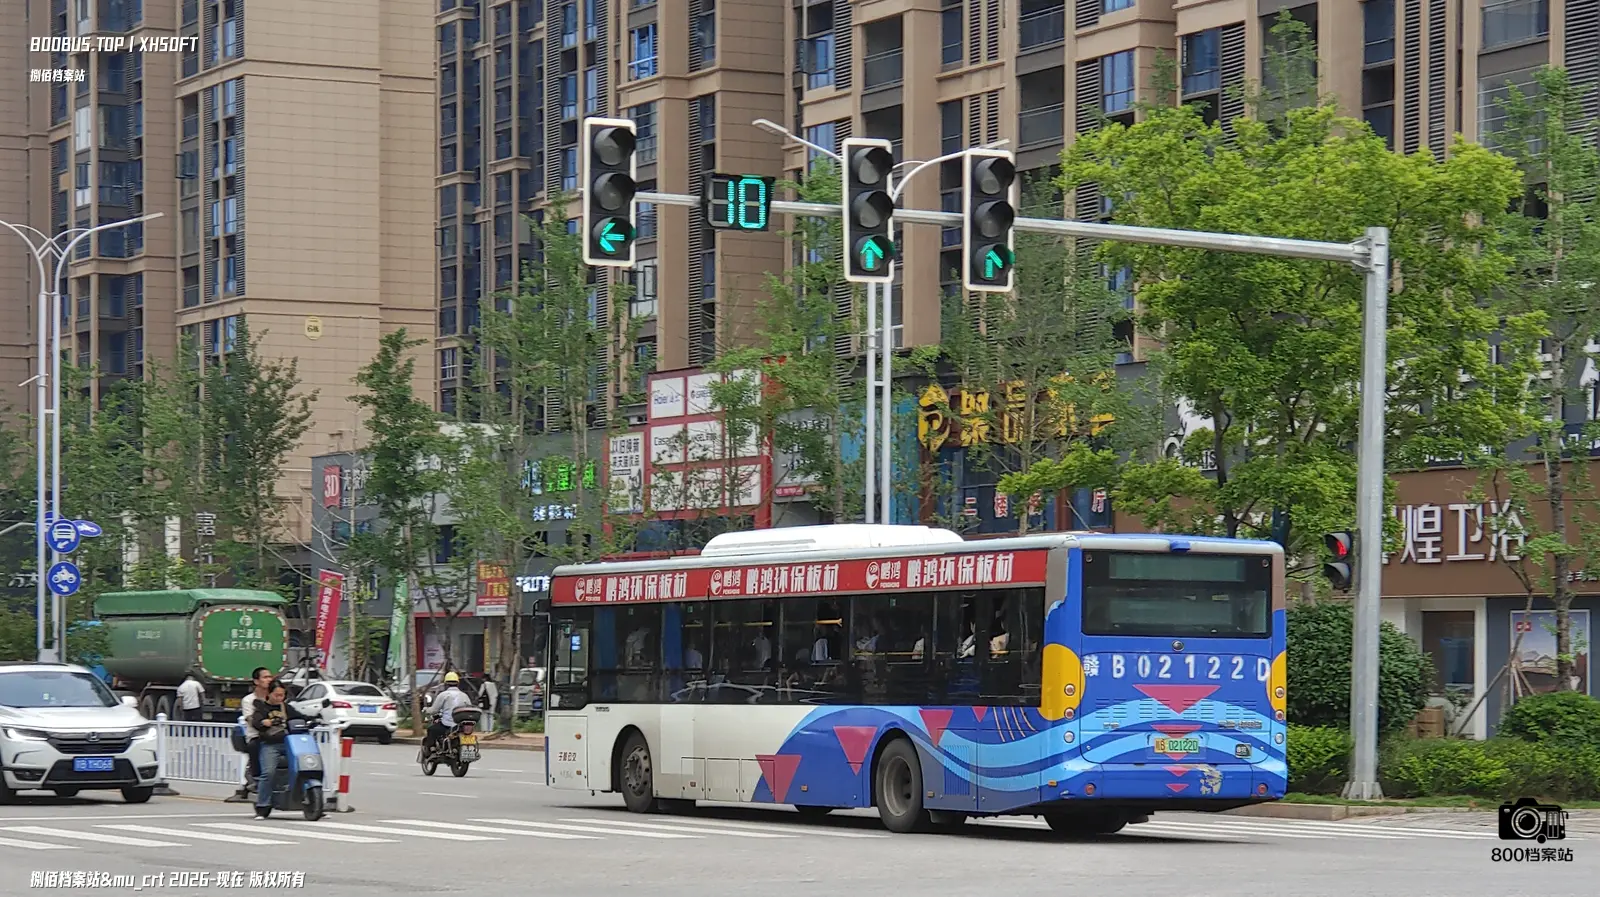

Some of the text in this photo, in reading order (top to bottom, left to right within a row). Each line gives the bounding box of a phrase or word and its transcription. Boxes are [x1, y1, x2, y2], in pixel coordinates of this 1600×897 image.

[727, 178, 766, 229] 10
[324, 474, 339, 498] 3D
[1382, 498, 1527, 565] 煌卫浴
[605, 571, 688, 602] 鹏鸿环保板材
[745, 563, 839, 595] 鹏鸿环保板材
[906, 552, 1015, 588] 鹏鸿环保板材
